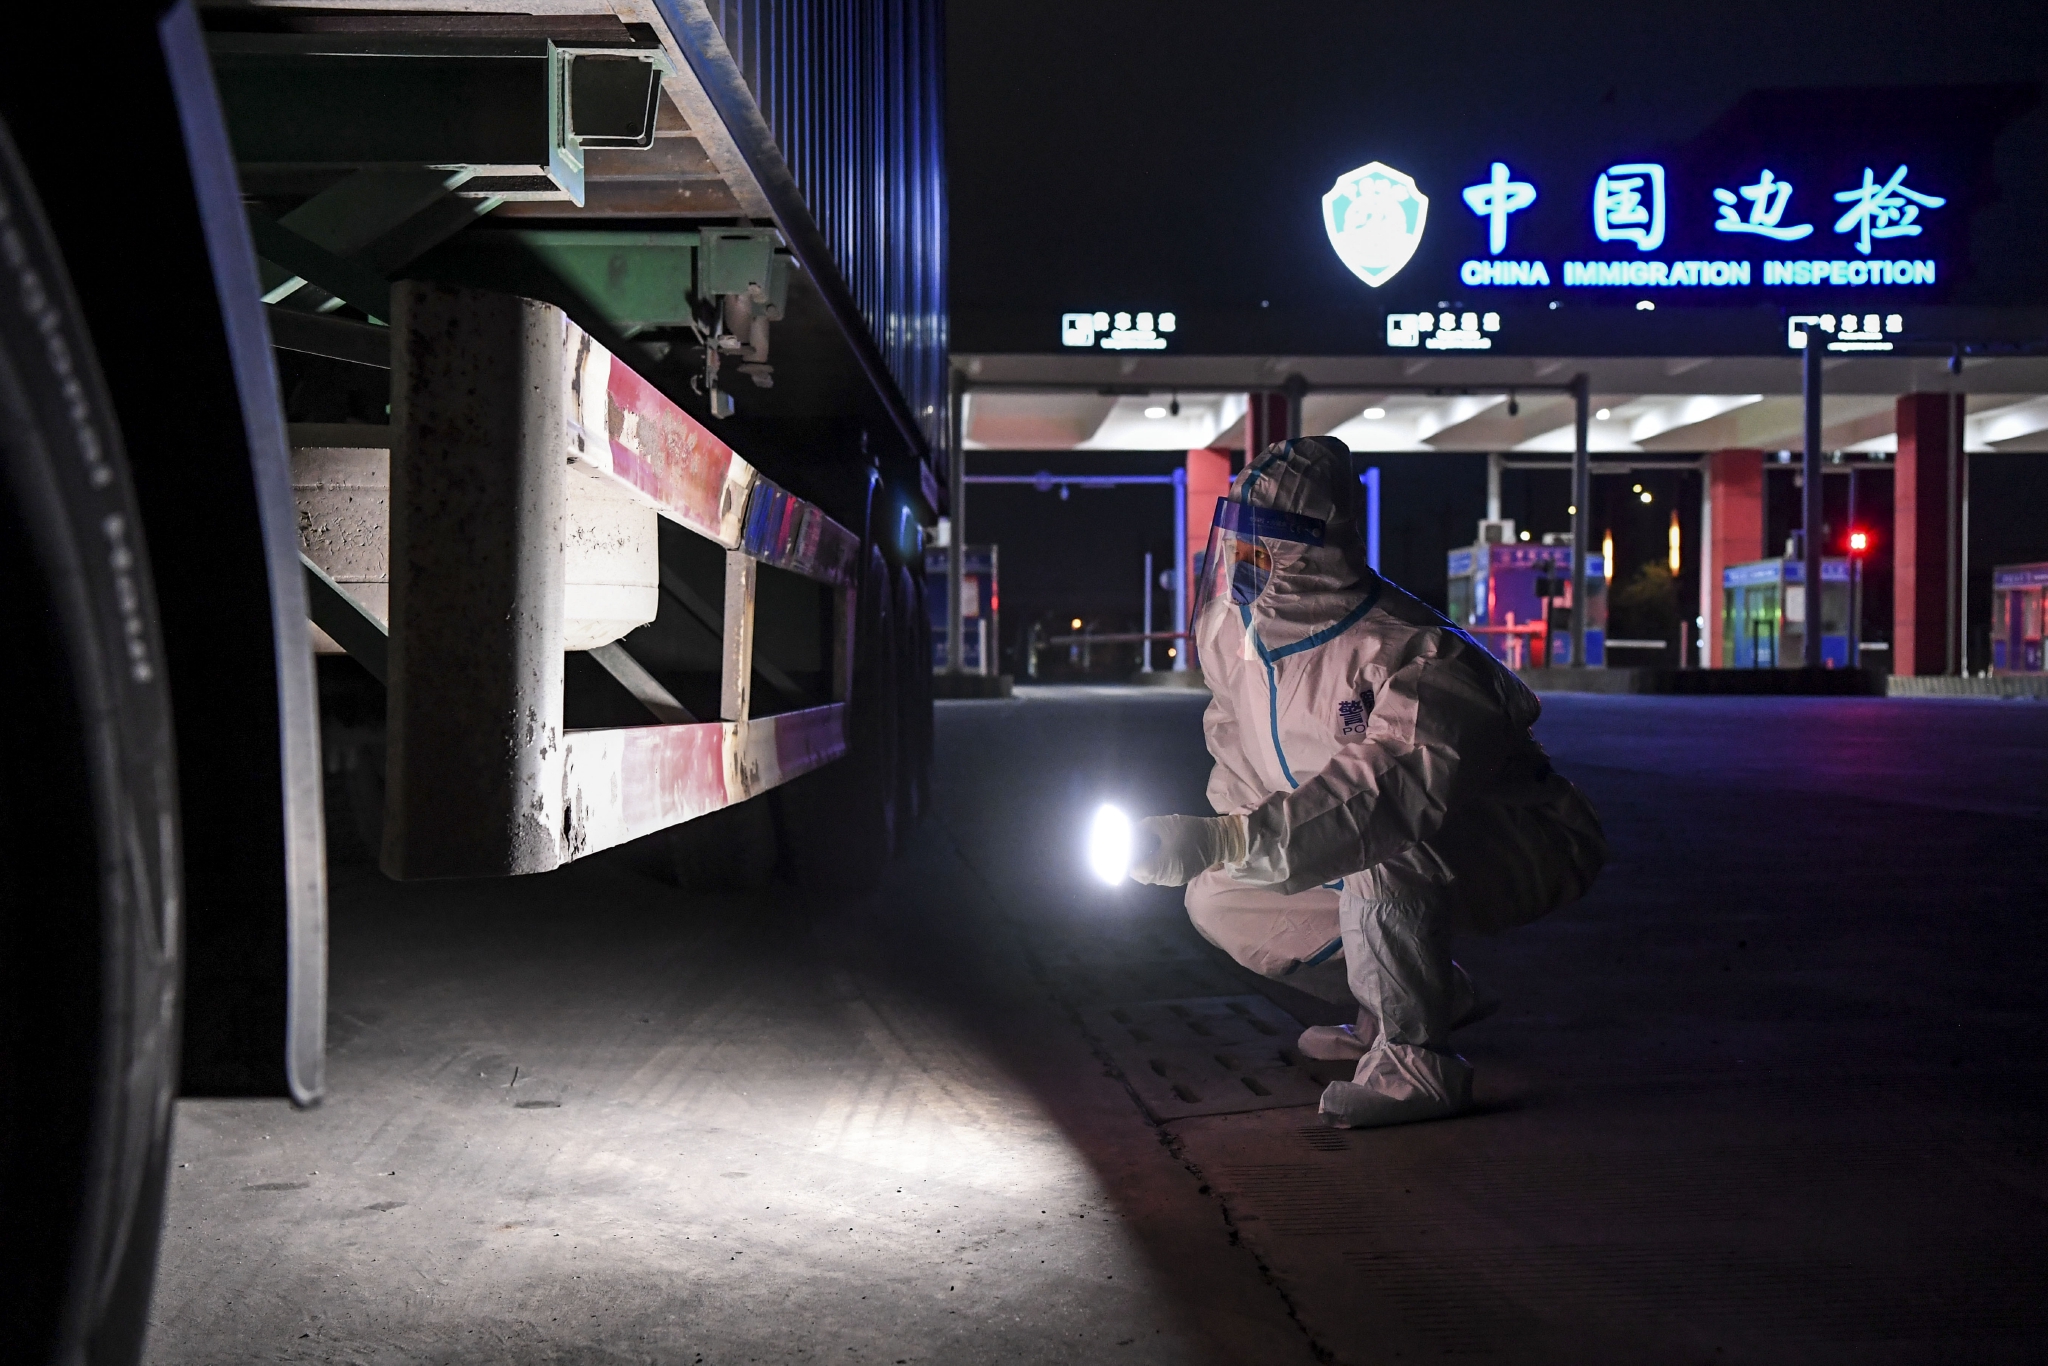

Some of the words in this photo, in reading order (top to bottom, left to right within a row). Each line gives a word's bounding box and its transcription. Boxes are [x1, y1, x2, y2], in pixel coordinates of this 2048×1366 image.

[1462, 161, 1947, 255] 中国边检
[1460, 259, 1551, 287] CHINA
[1562, 260, 1751, 287] IMMIGRATION
[1763, 259, 1937, 286] INSPECTION
